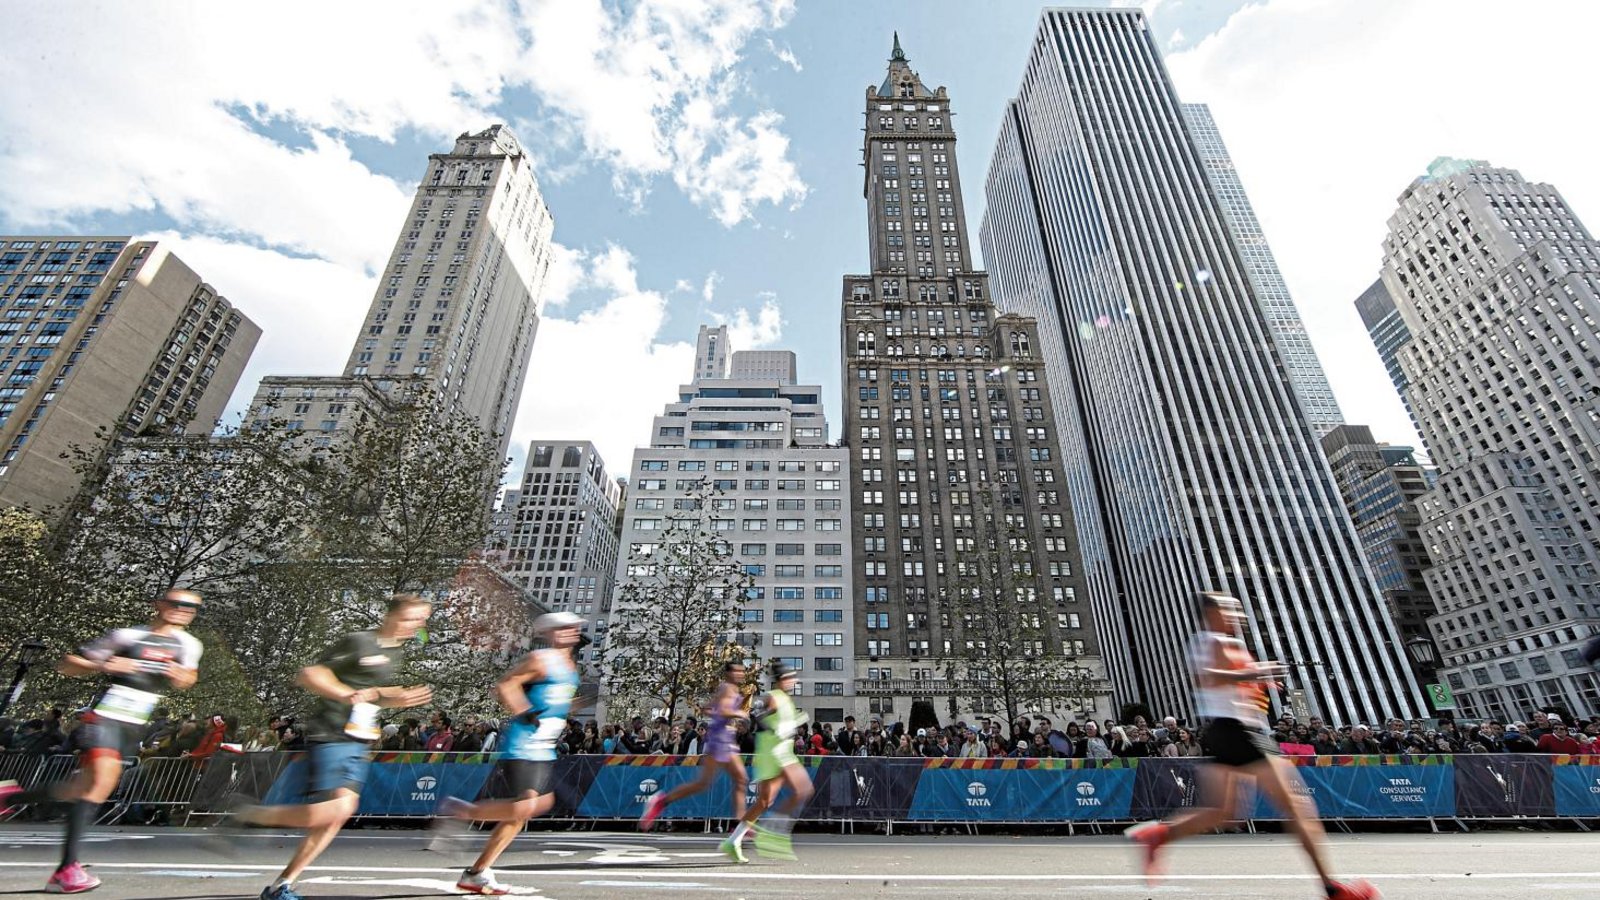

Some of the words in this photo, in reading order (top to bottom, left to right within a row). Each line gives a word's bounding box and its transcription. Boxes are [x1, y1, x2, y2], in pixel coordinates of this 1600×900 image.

[1389, 778, 1411, 786] TATA
[1379, 786, 1426, 794] CONSULTANCY
[410, 792, 436, 801] TATA
[1390, 794, 1423, 802] SERVICES
[965, 798, 992, 807] TATA
[1075, 797, 1101, 806] TATA
